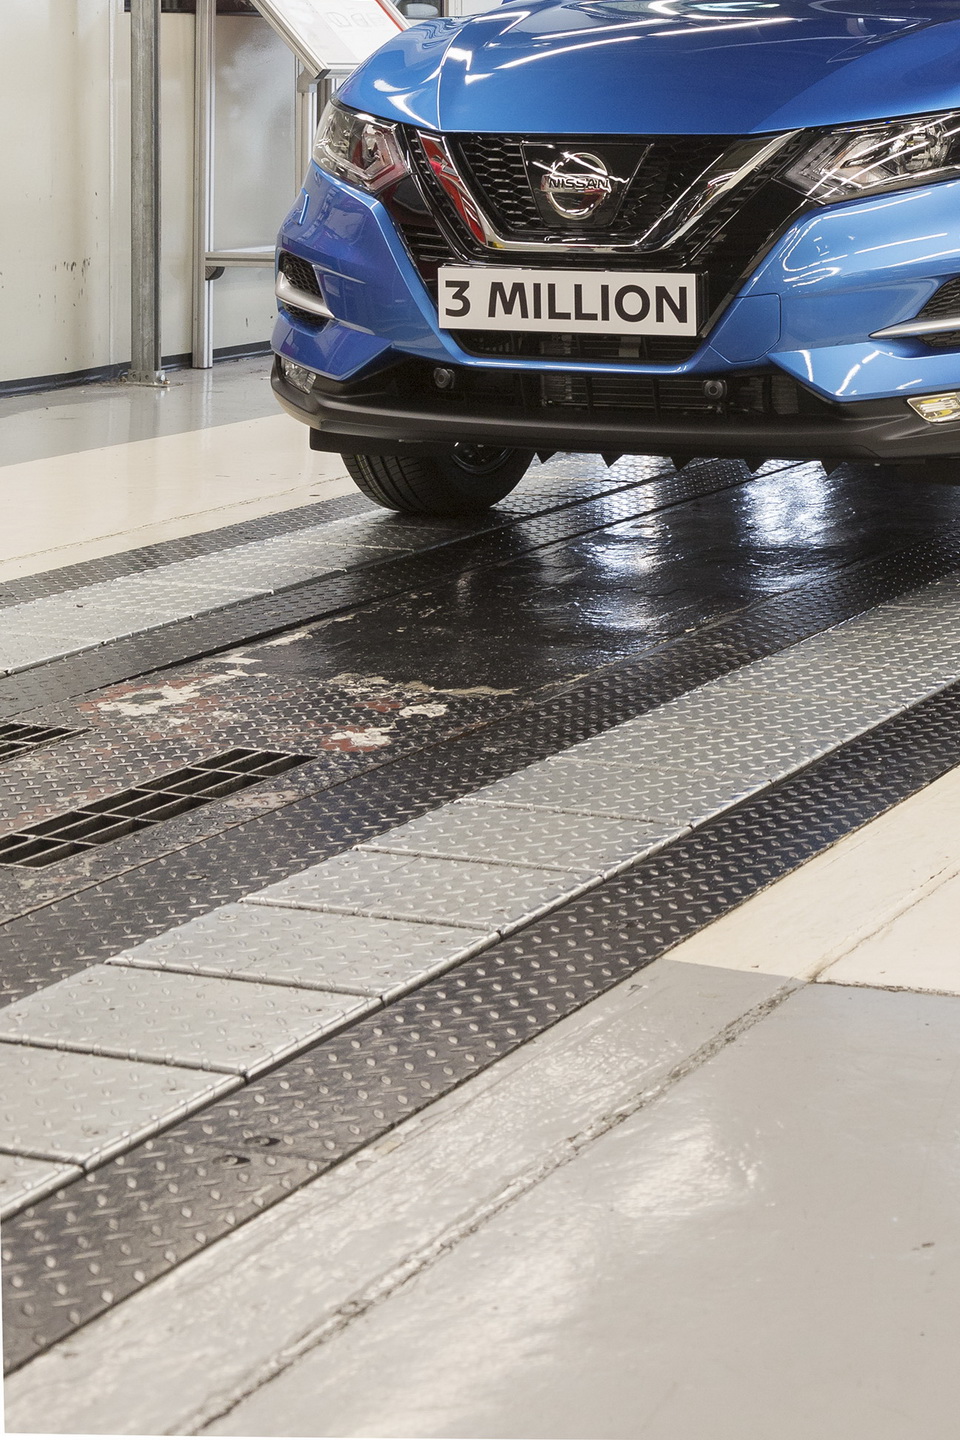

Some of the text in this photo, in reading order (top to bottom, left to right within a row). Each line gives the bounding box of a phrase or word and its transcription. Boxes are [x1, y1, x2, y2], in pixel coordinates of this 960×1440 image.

[548, 177, 609, 189] NISSAN
[445, 280, 688, 324] 3 MILLION
